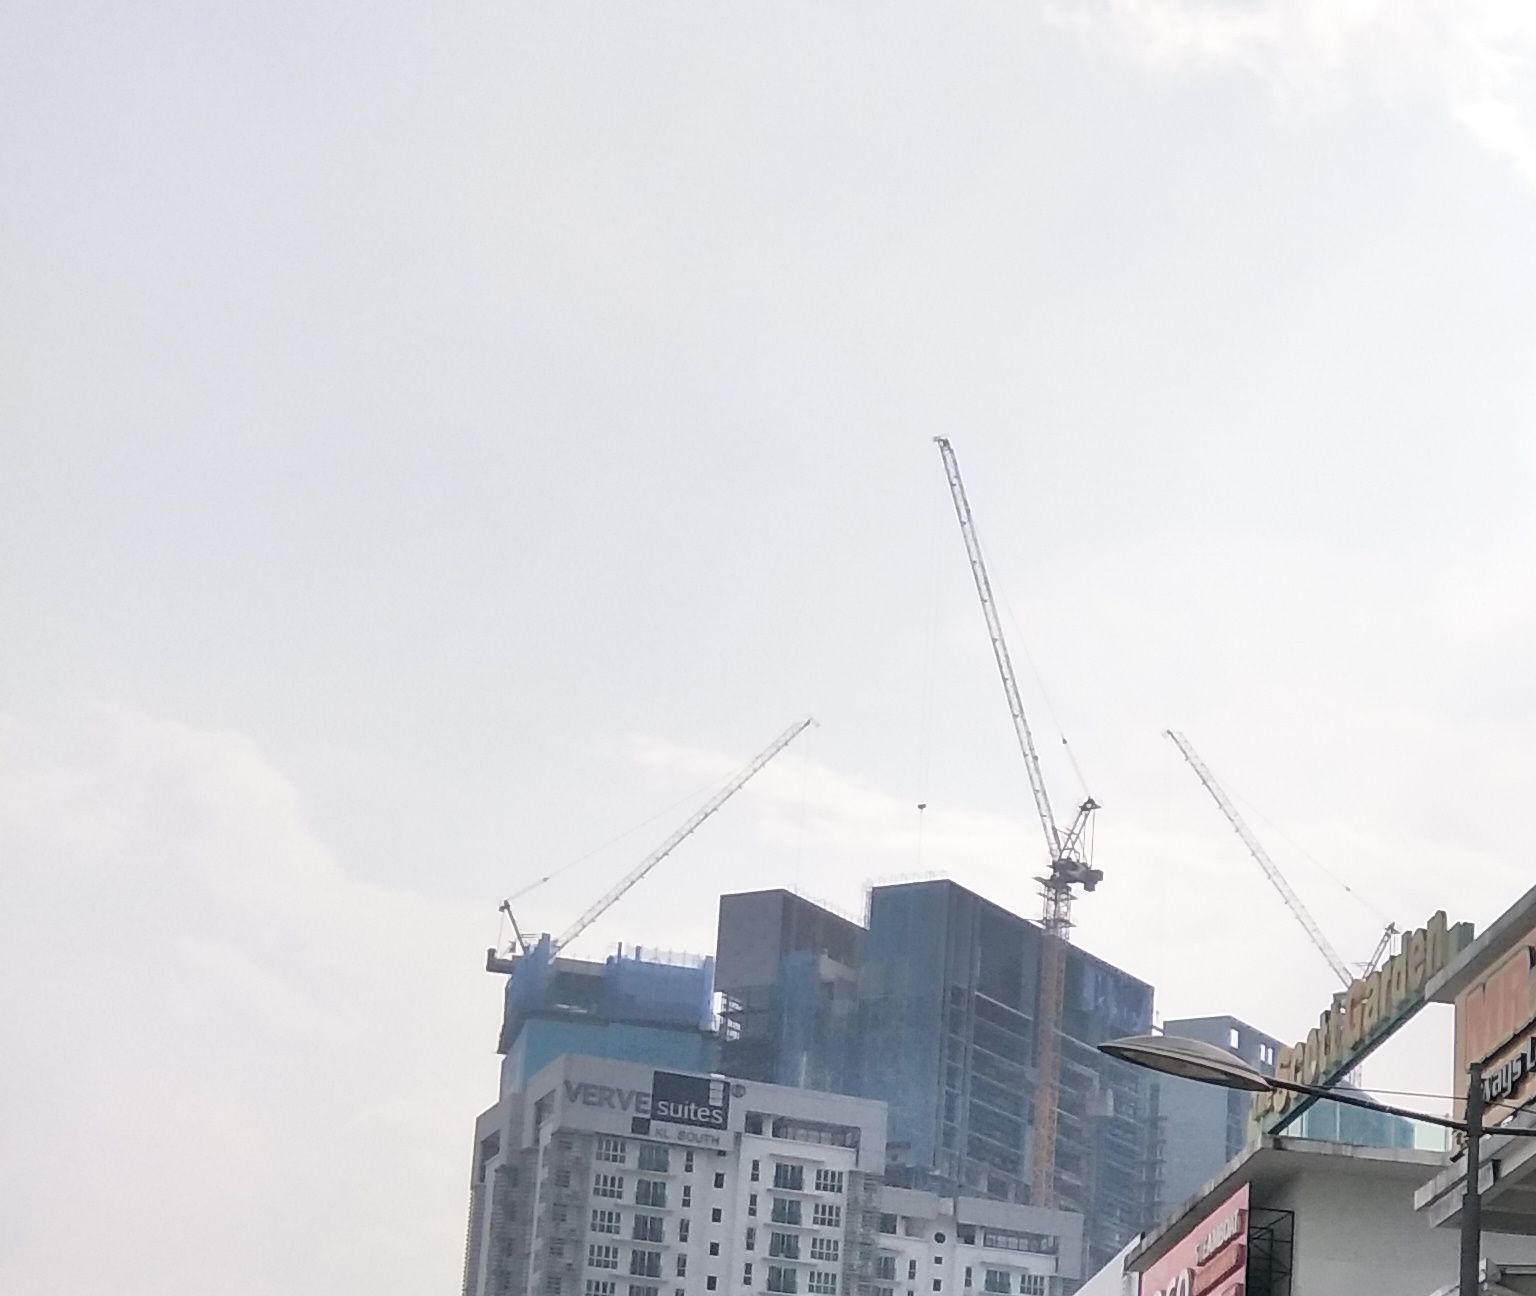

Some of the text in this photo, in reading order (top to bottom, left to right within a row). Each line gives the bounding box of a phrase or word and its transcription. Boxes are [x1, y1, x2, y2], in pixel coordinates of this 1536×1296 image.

[562, 1079, 650, 1115] VERVE
[657, 1099, 723, 1124] suites
[677, 1129, 720, 1146] SOUTH
